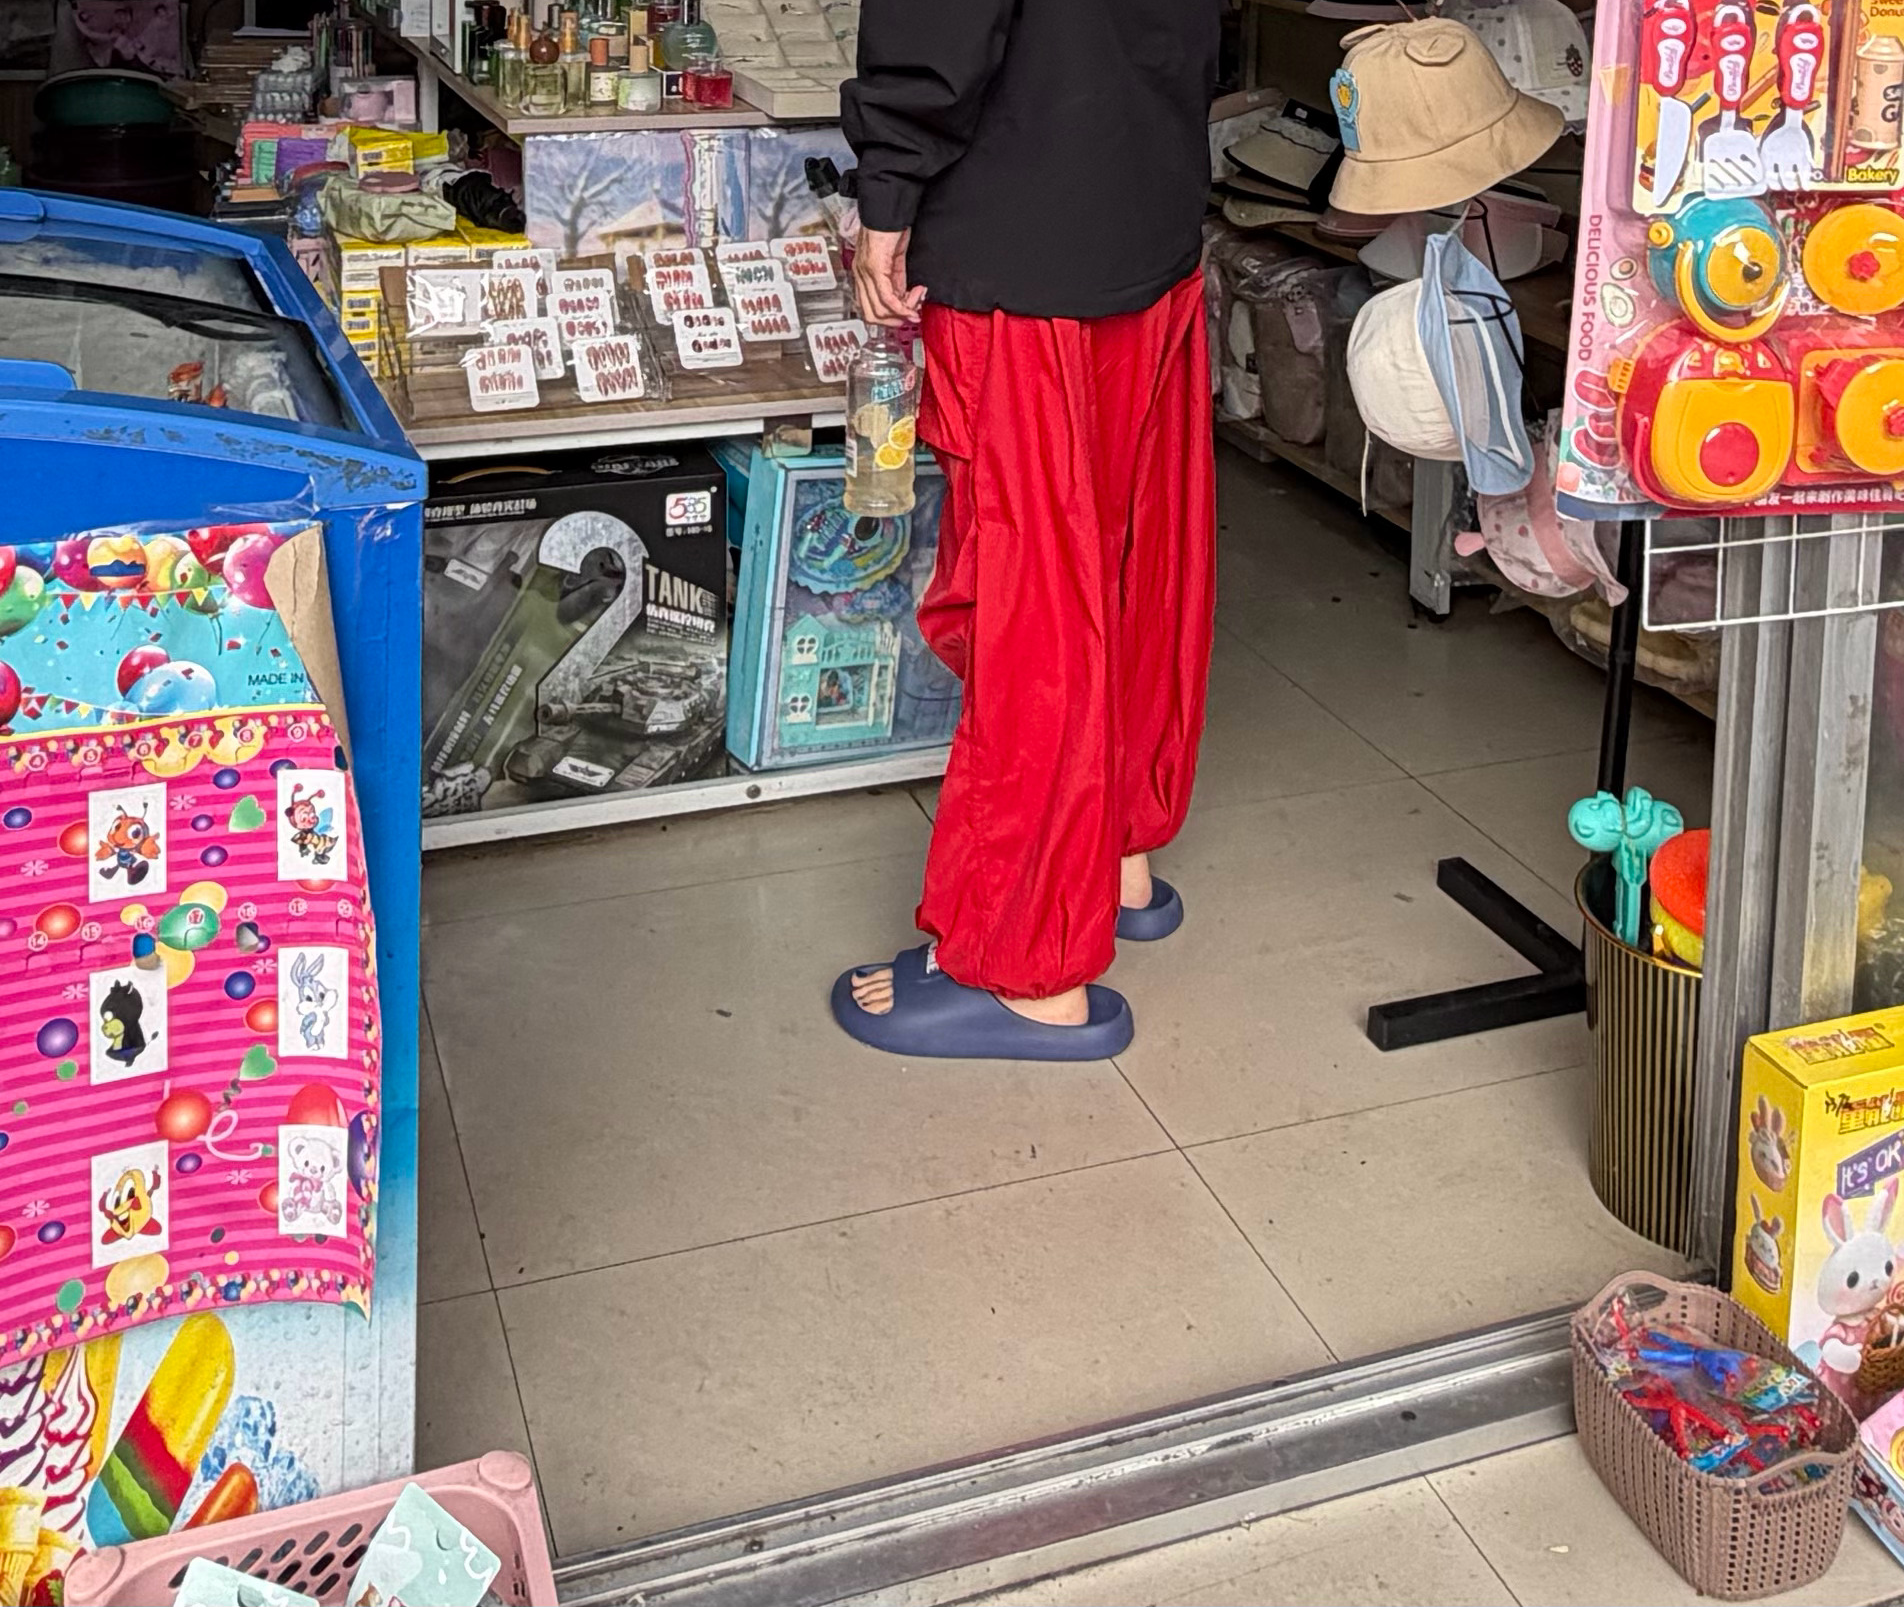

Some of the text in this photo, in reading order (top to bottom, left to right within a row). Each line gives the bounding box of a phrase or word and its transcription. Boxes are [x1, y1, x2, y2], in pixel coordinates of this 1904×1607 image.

[1847, 166, 1900, 185] Bakery
[1578, 213, 1604, 362] DELICIOUS FOOD
[646, 563, 707, 616] TANK
[248, 672, 304, 687] MADE IN
[1872, 1142, 1904, 1173] OK
